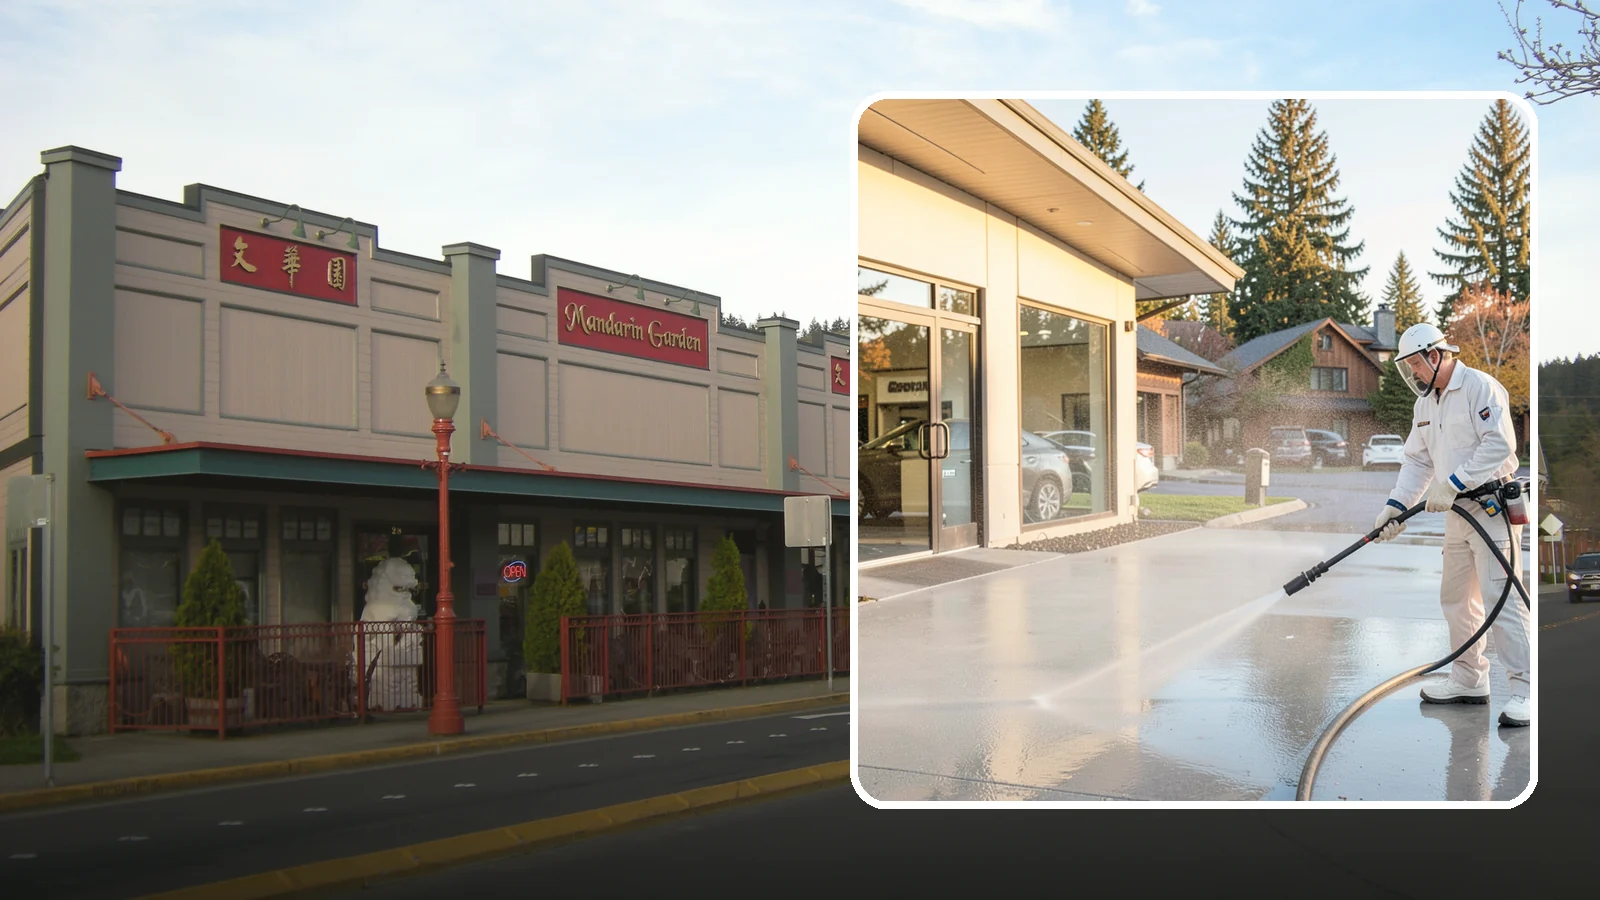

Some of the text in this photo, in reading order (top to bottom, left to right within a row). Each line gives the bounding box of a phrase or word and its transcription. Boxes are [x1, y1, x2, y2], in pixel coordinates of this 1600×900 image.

[230, 235, 346, 291] 文華園
[564, 302, 702, 353] Mandarin Garden
[503, 565, 527, 579] OPEN
